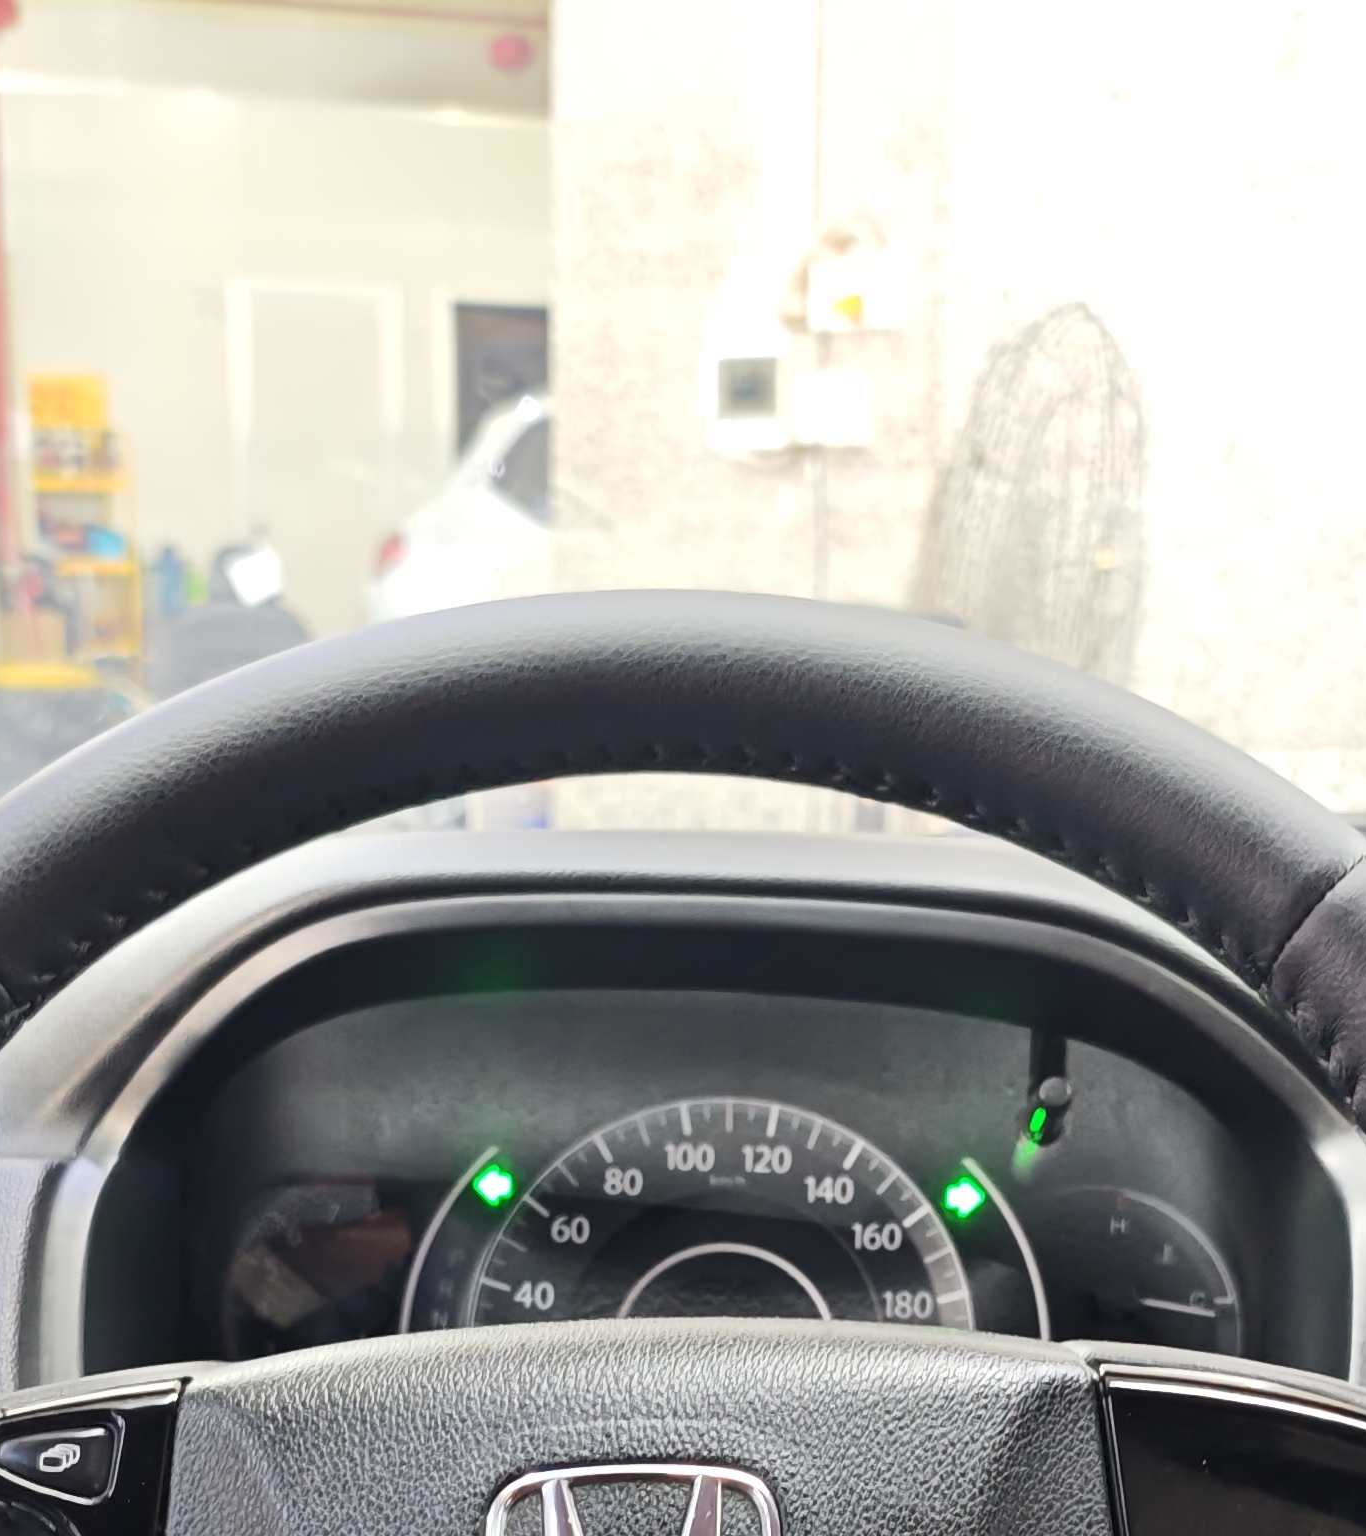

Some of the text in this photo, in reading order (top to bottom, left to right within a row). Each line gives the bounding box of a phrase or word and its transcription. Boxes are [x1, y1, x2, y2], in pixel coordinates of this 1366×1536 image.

[665, 1142, 715, 1171] 100
[742, 1144, 792, 1174] 120
[603, 1167, 643, 1196] 80
[804, 1175, 855, 1204] 140
[550, 1216, 590, 1244] 60
[851, 1222, 903, 1251] 160
[513, 1281, 555, 1310] 40
[882, 1289, 933, 1319] 180
